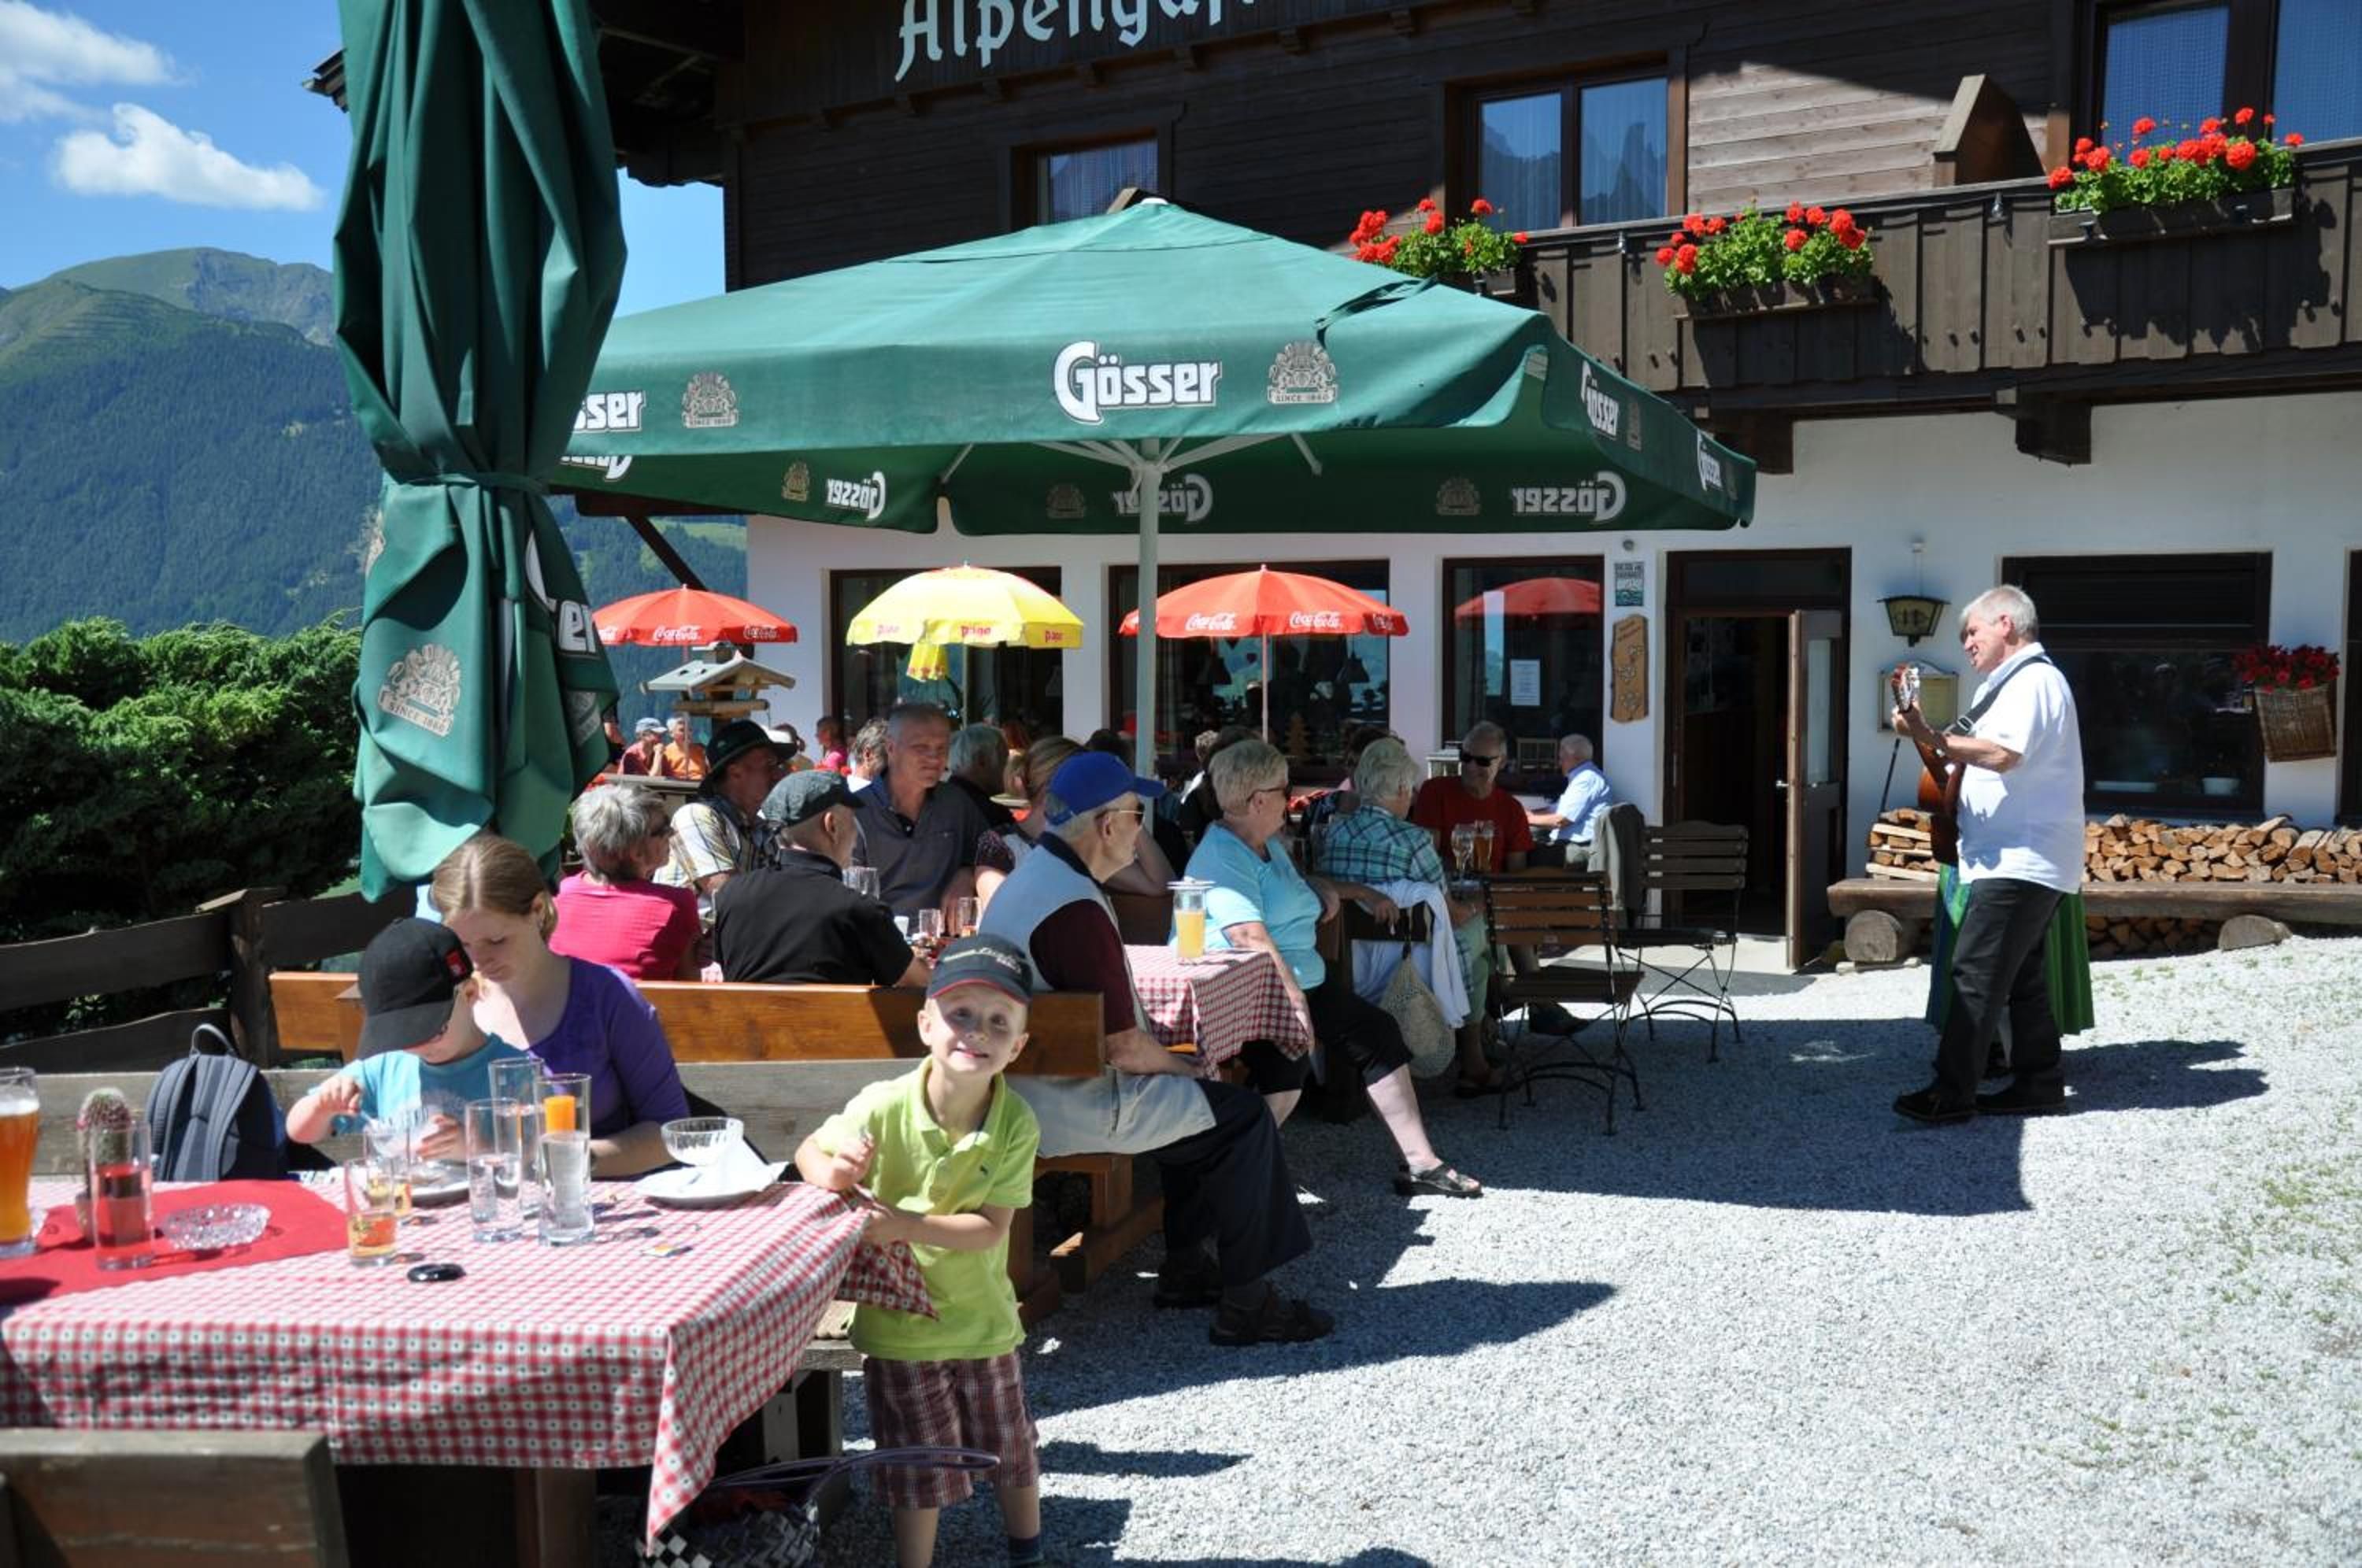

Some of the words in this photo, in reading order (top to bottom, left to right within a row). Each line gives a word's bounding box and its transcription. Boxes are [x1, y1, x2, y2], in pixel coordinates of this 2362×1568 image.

[1053, 340, 1220, 423] Gösser
[1581, 360, 1620, 437] Gösser
[1185, 612, 1237, 630] Coca-Cola
[1289, 612, 1343, 629] Coca-Cola
[652, 624, 702, 642] Coca-Cola
